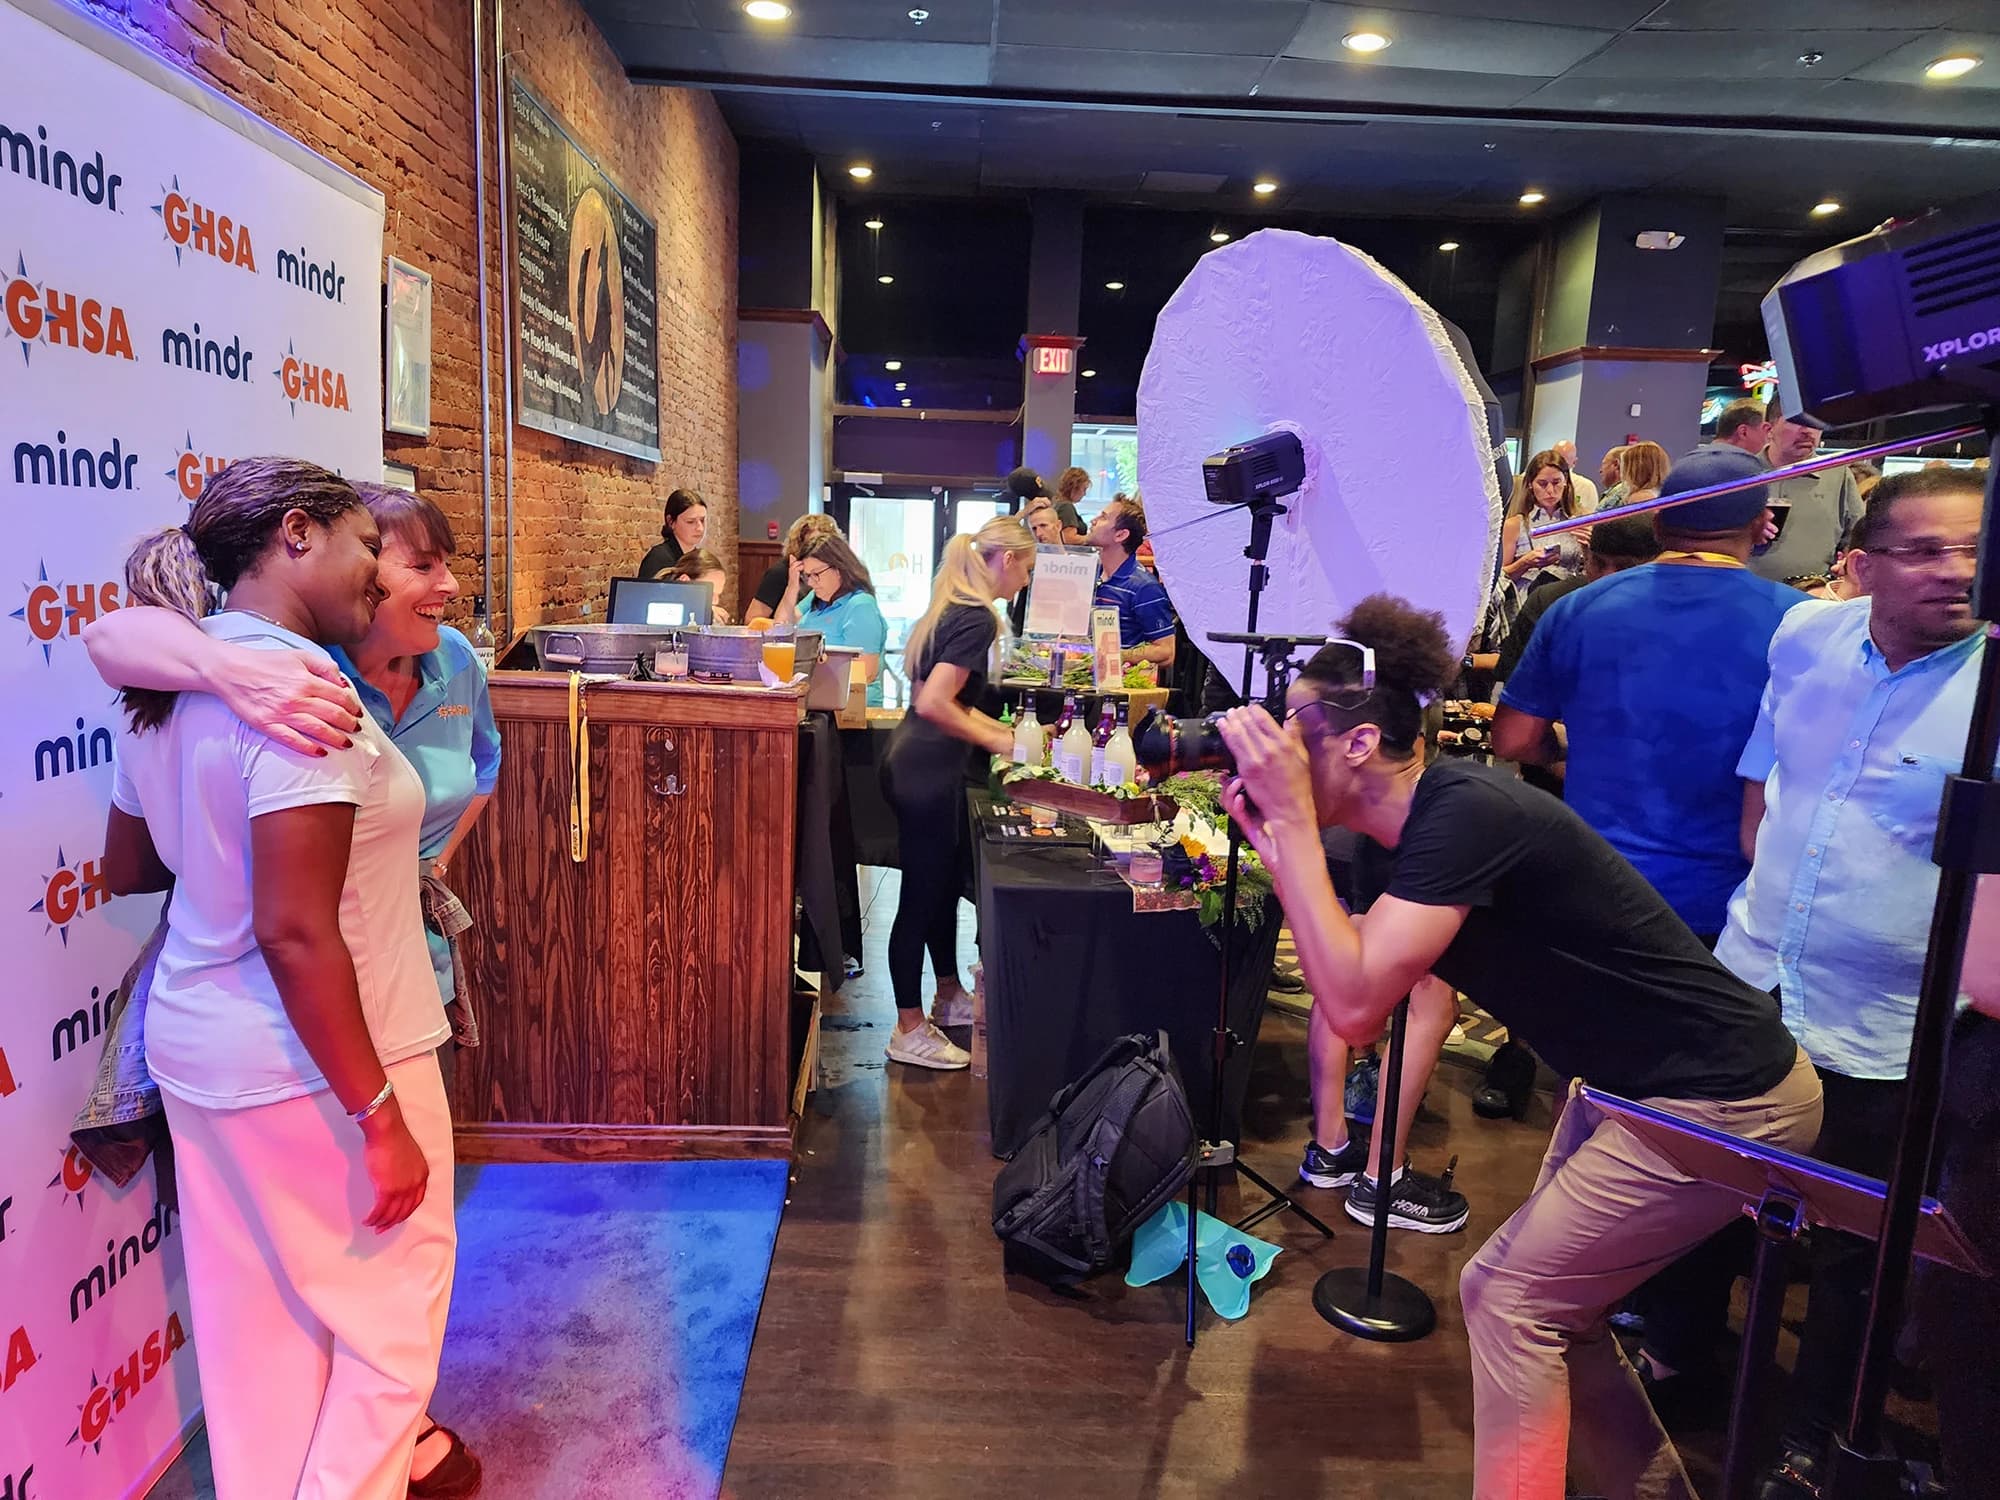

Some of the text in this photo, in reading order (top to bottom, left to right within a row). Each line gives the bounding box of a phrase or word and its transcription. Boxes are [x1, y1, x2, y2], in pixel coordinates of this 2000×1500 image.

[0, 124, 122, 212] mindr
[163, 192, 256, 273] GHSA
[277, 246, 345, 304] mindr
[5, 278, 135, 361] GHSA
[1922, 327, 2000, 362] XPLOR
[162, 323, 254, 383] mindr
[1039, 347, 1069, 372] EXIT
[282, 356, 350, 413] GHSA
[14, 430, 139, 490] mindr
[35, 716, 113, 782] min
[45, 855, 113, 927] GH
[1391, 1198, 1429, 1217] HOKA
[81, 1311, 187, 1444] GHSA
